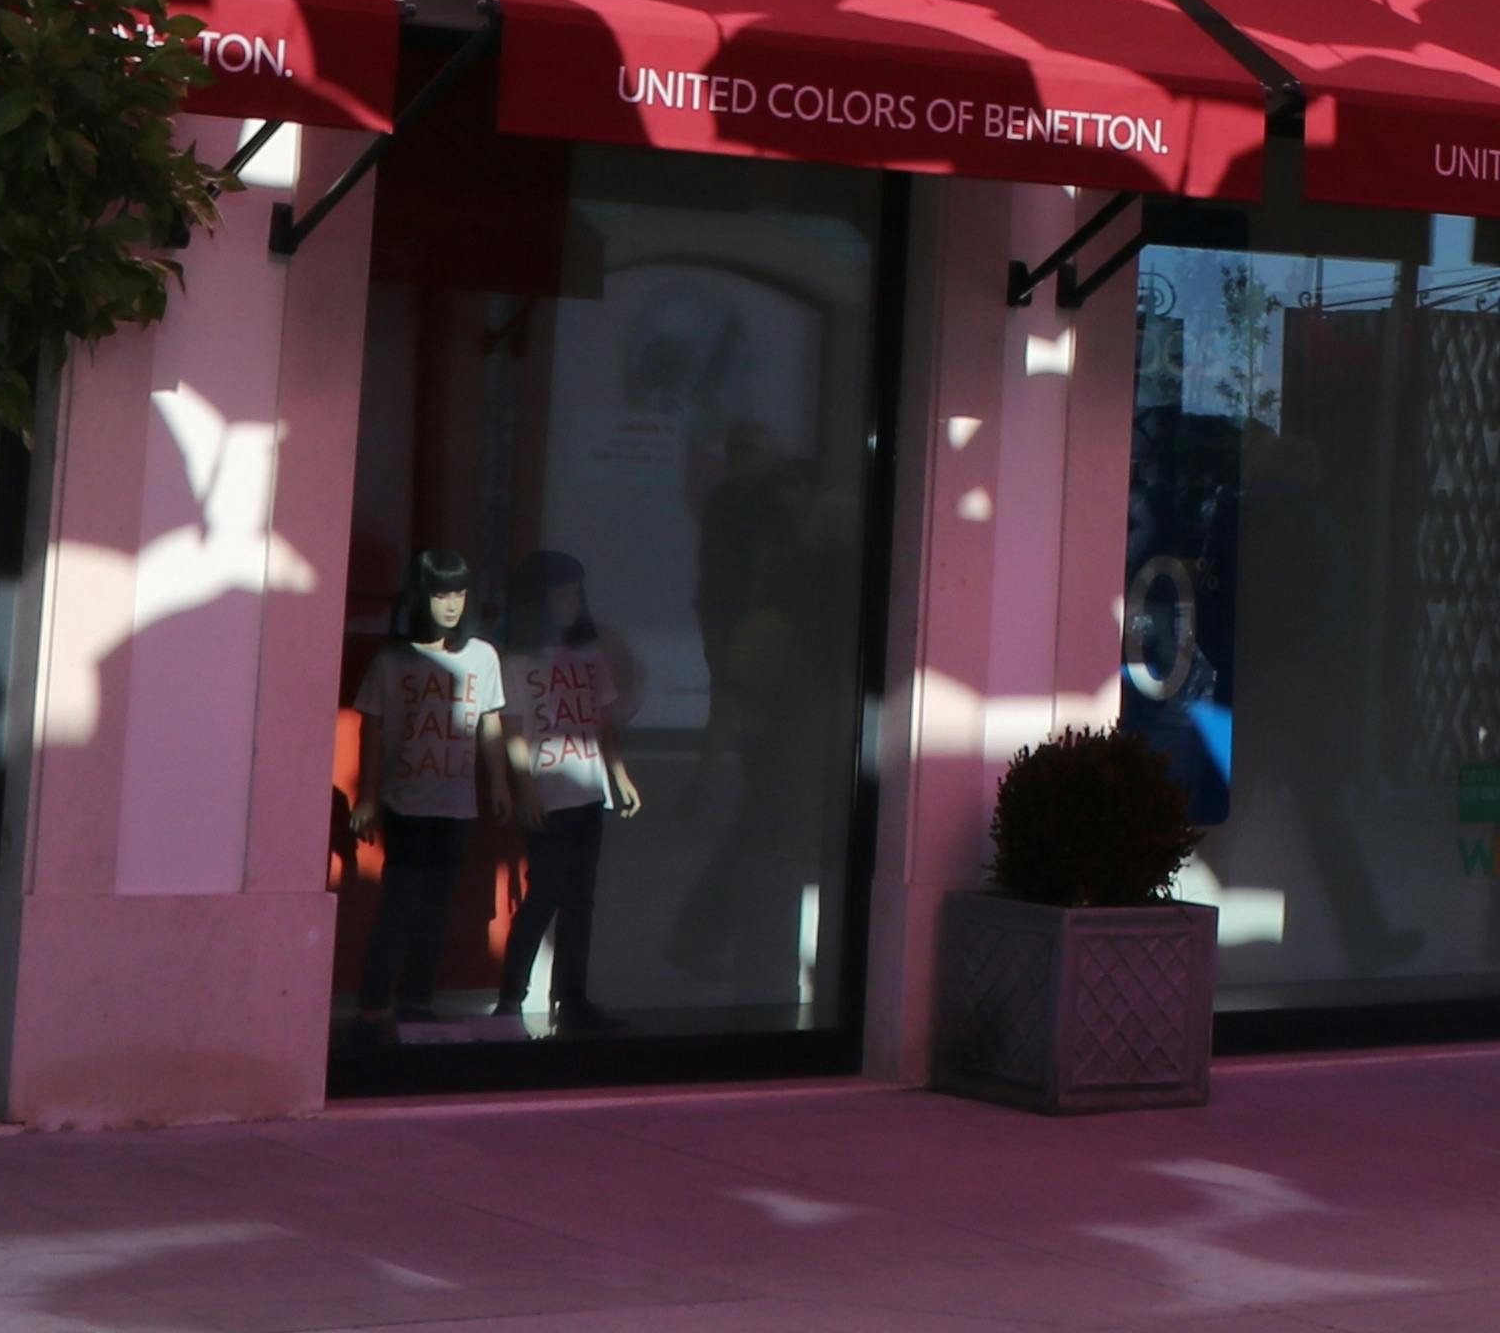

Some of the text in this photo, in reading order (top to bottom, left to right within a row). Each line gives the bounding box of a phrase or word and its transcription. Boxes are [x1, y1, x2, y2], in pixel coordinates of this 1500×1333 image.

[617, 65, 1169, 155] UNITED COLORS OF BENETTON.
[400, 672, 478, 705] SALE
[403, 711, 475, 742] SALE
[396, 746, 471, 779] SALE
